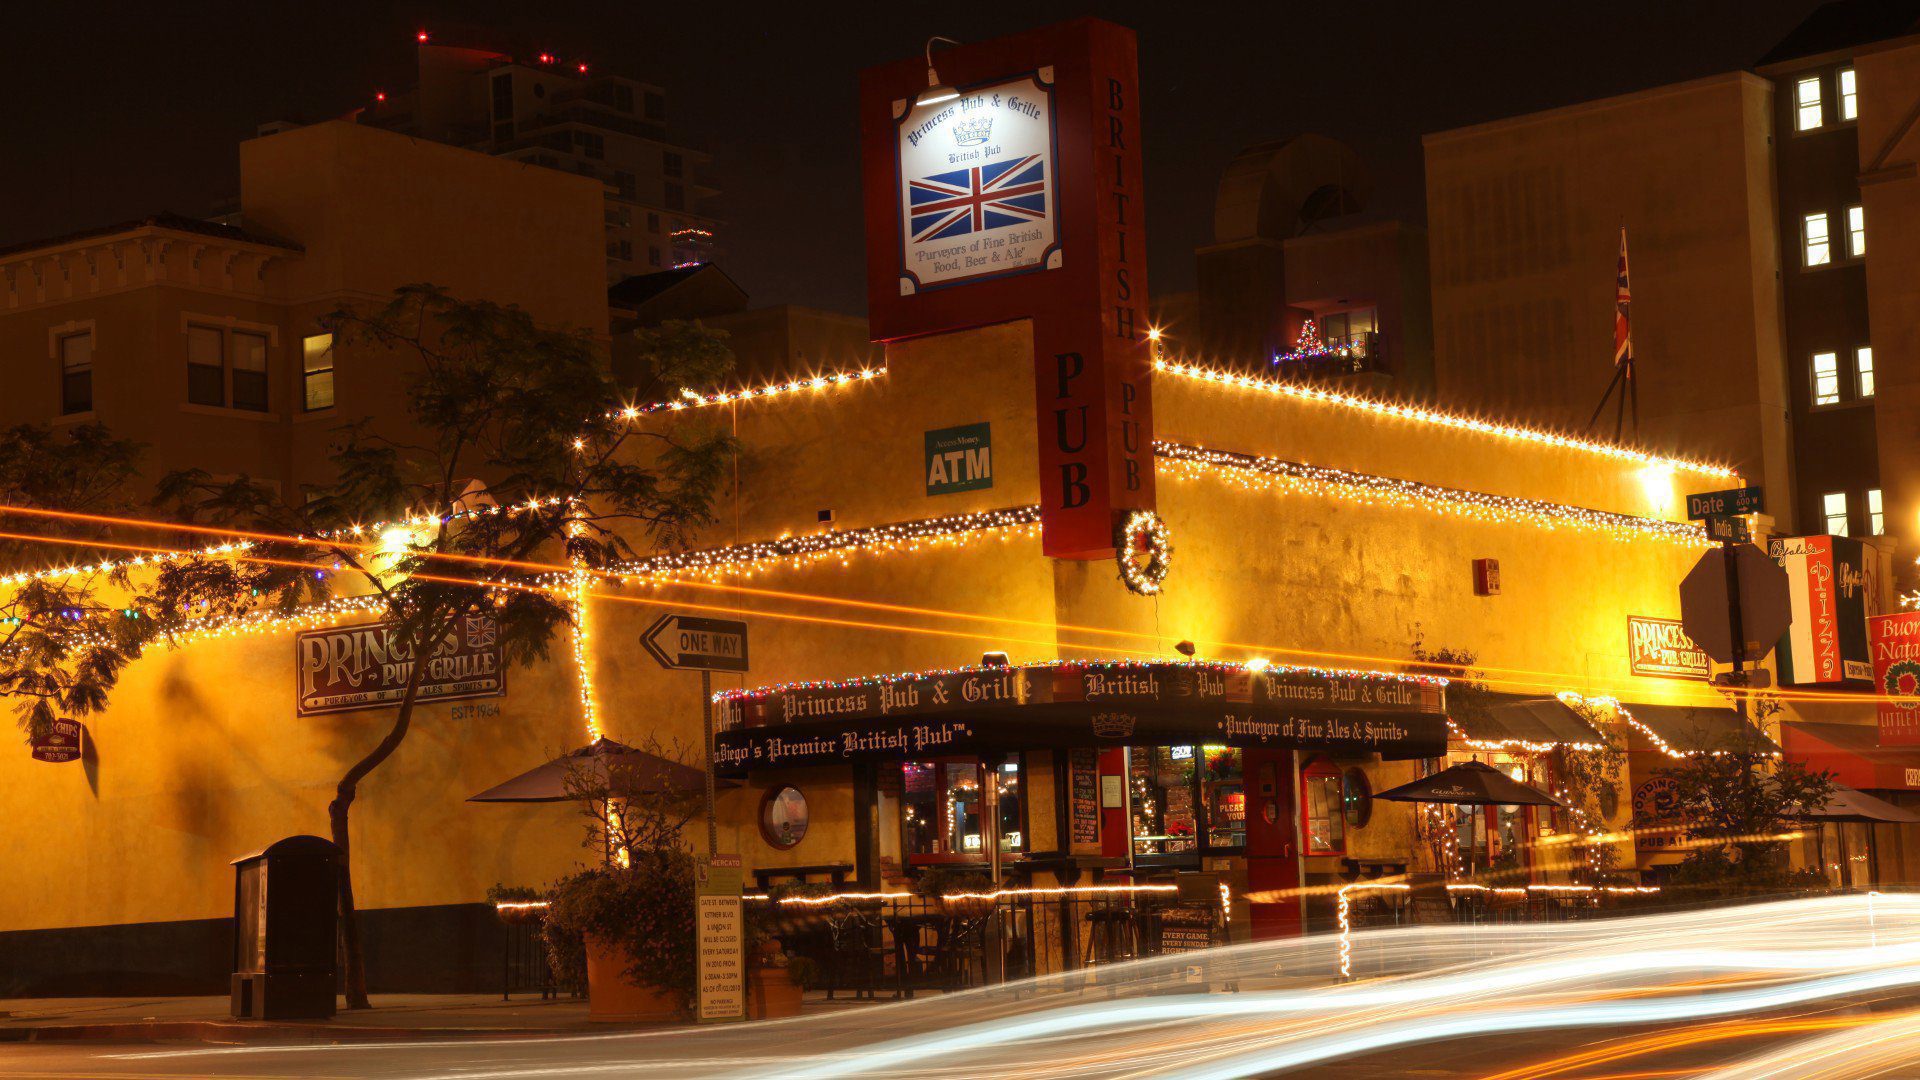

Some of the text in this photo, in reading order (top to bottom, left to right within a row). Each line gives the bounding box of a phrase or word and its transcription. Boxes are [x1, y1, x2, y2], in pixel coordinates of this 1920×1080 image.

[907, 94, 1041, 147] Princess Pub & Grille
[948, 145, 1001, 164] British Pub
[970, 240, 979, 252] of
[983, 236, 1005, 249] Fine
[1008, 229, 1043, 245] British
[933, 259, 961, 274] Food,
[965, 255, 987, 268] Beer
[991, 252, 1001, 263] &
[1107, 78, 1141, 492] BRITISH PUB
[1054, 352, 1091, 510] PUB
[928, 446, 990, 486] ATM
[1692, 489, 1746, 515] Date ST
[1736, 497, 1750, 506] 600
[1714, 518, 1732, 538] India
[680, 632, 738, 656] ONE WAY
[302, 624, 459, 699] PRINCS
[431, 652, 496, 681] GRILLE
[1680, 651, 1707, 667] GRILLE
[324, 692, 368, 706] PURVEYORS
[377, 691, 386, 700] OF
[422, 685, 443, 694] ALES
[452, 681, 483, 692] SPIRITS
[1084, 671, 1224, 702] British Pub
[1266, 677, 1412, 705] Princess Pub & Grille
[475, 703, 500, 718] 1984
[782, 675, 1032, 723] Princess Pub & Grille
[56, 722, 78, 738] CHIPS
[1224, 714, 1402, 745] Purveyor of Fine Ales & Spirits
[1881, 711, 1911, 728] LITTLE
[719, 738, 762, 767] Diego's
[767, 737, 836, 762] Premier
[842, 727, 909, 758] British
[1431, 788, 1476, 796] GUINNESS
[1640, 837, 1664, 847] PUB
[711, 859, 740, 867] MERCATO
[1186, 932, 1210, 940] GAME.
